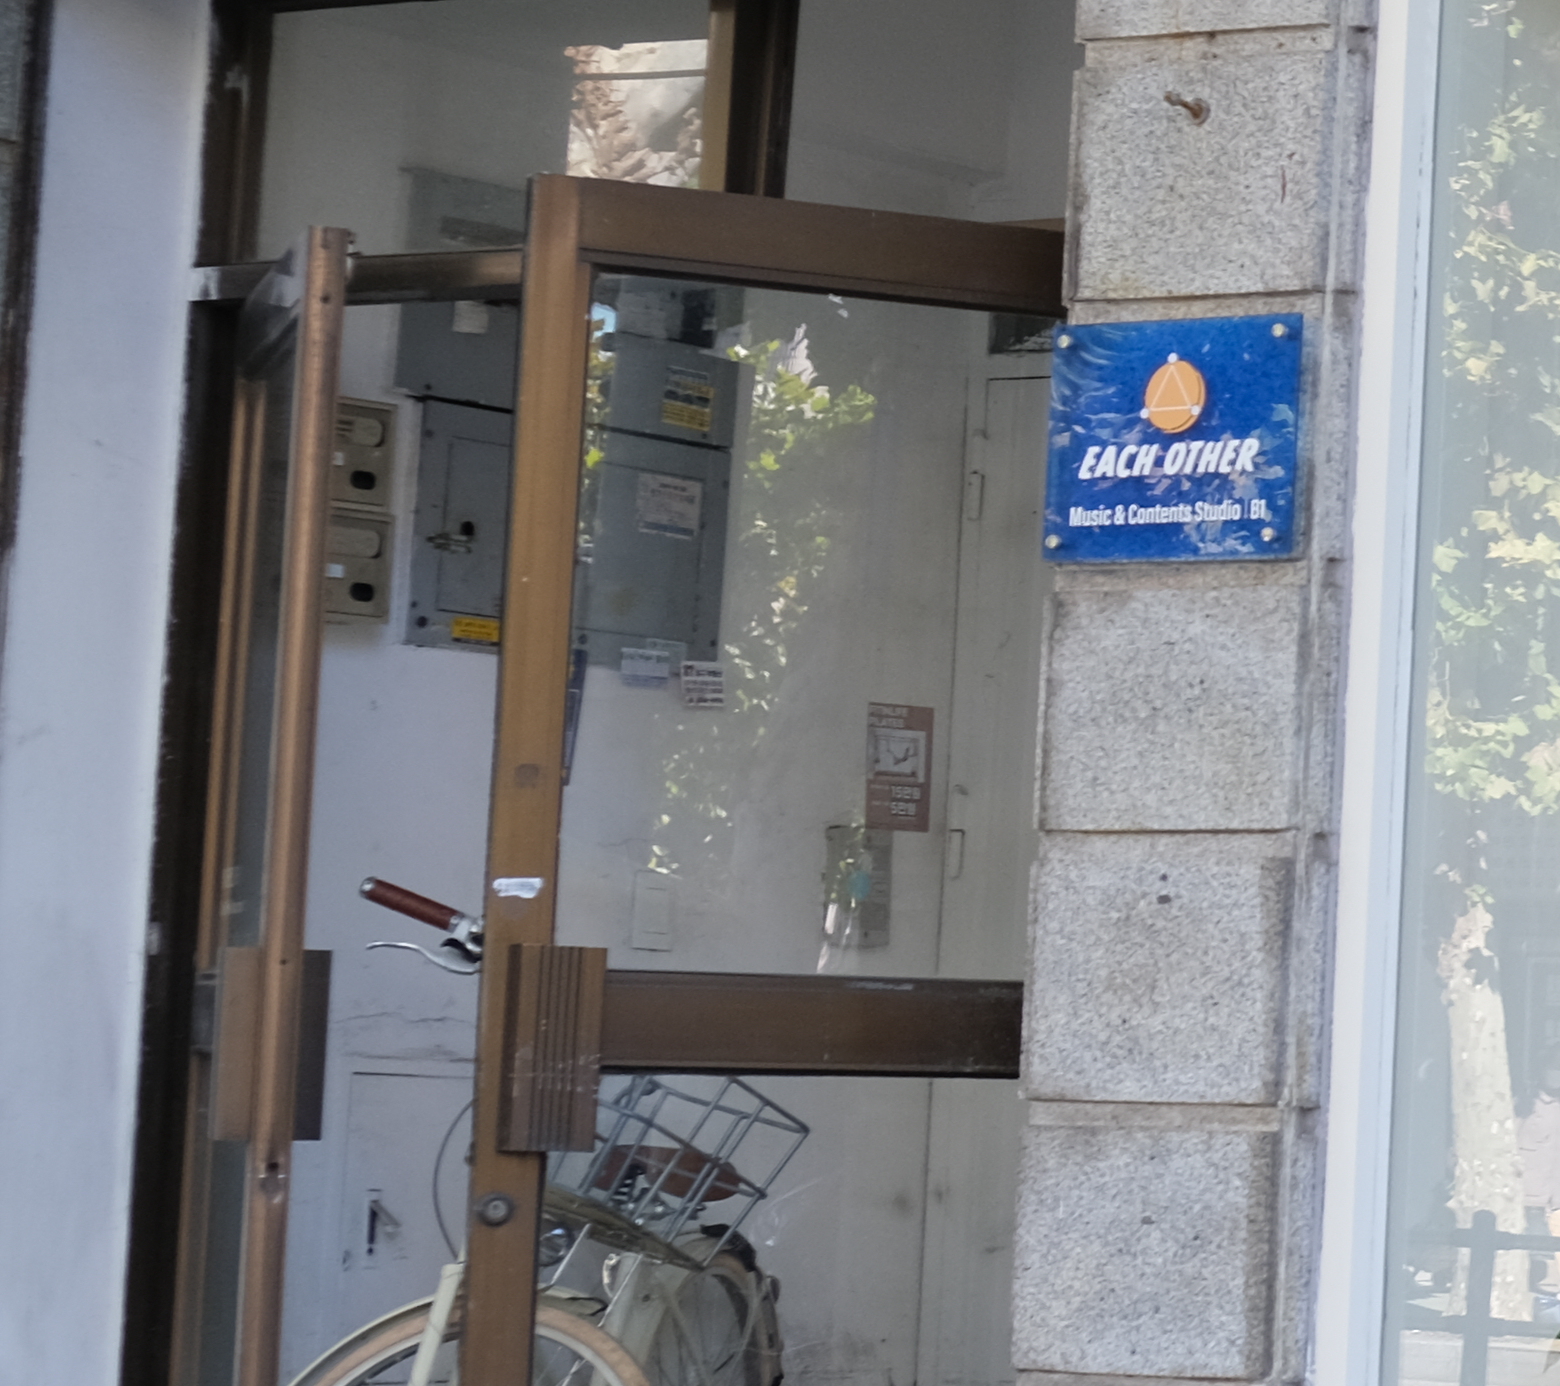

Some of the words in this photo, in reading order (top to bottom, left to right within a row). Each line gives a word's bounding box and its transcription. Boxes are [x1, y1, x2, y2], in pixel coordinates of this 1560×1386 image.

[1078, 443, 1160, 480] EACH
[1162, 437, 1262, 475] OTHER
[1069, 504, 1111, 527] Music
[1113, 504, 1125, 525] &
[1127, 501, 1193, 525] Contents
[1193, 499, 1242, 522] Studio
